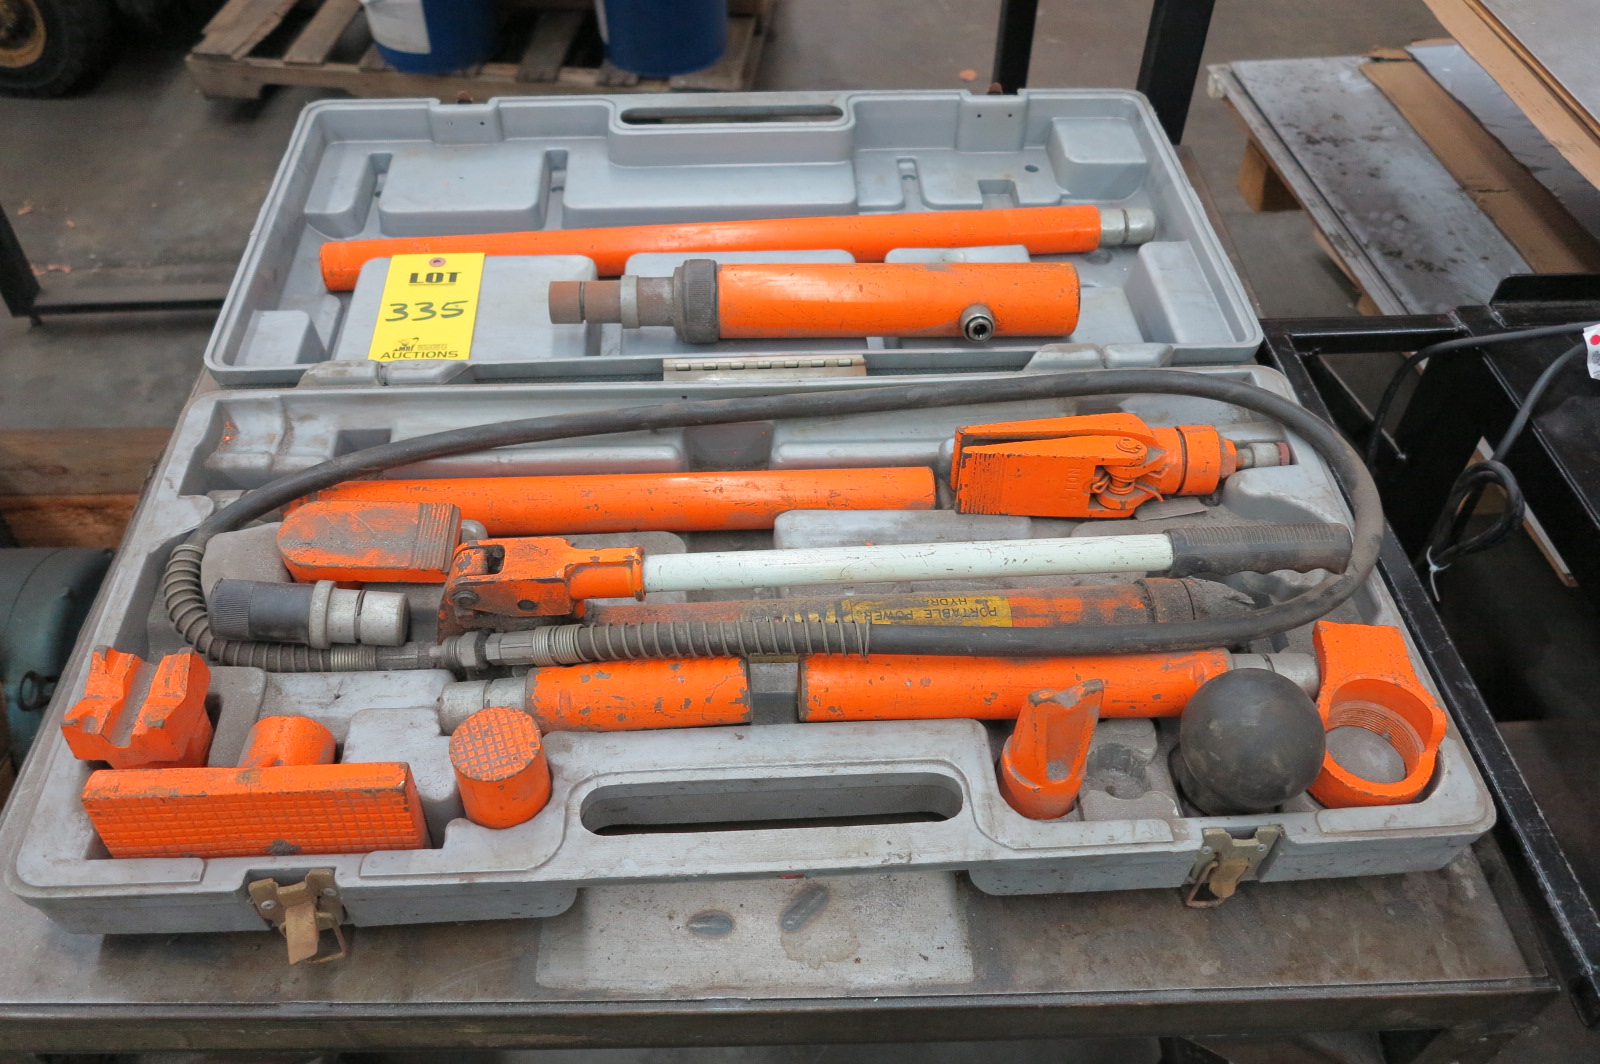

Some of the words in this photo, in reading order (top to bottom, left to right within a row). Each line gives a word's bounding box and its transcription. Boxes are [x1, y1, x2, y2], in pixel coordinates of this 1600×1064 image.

[409, 272, 462, 284] LOT
[385, 300, 469, 322] 335
[380, 351, 459, 360] AUCTIONS
[924, 606, 998, 619] PORTABLE
